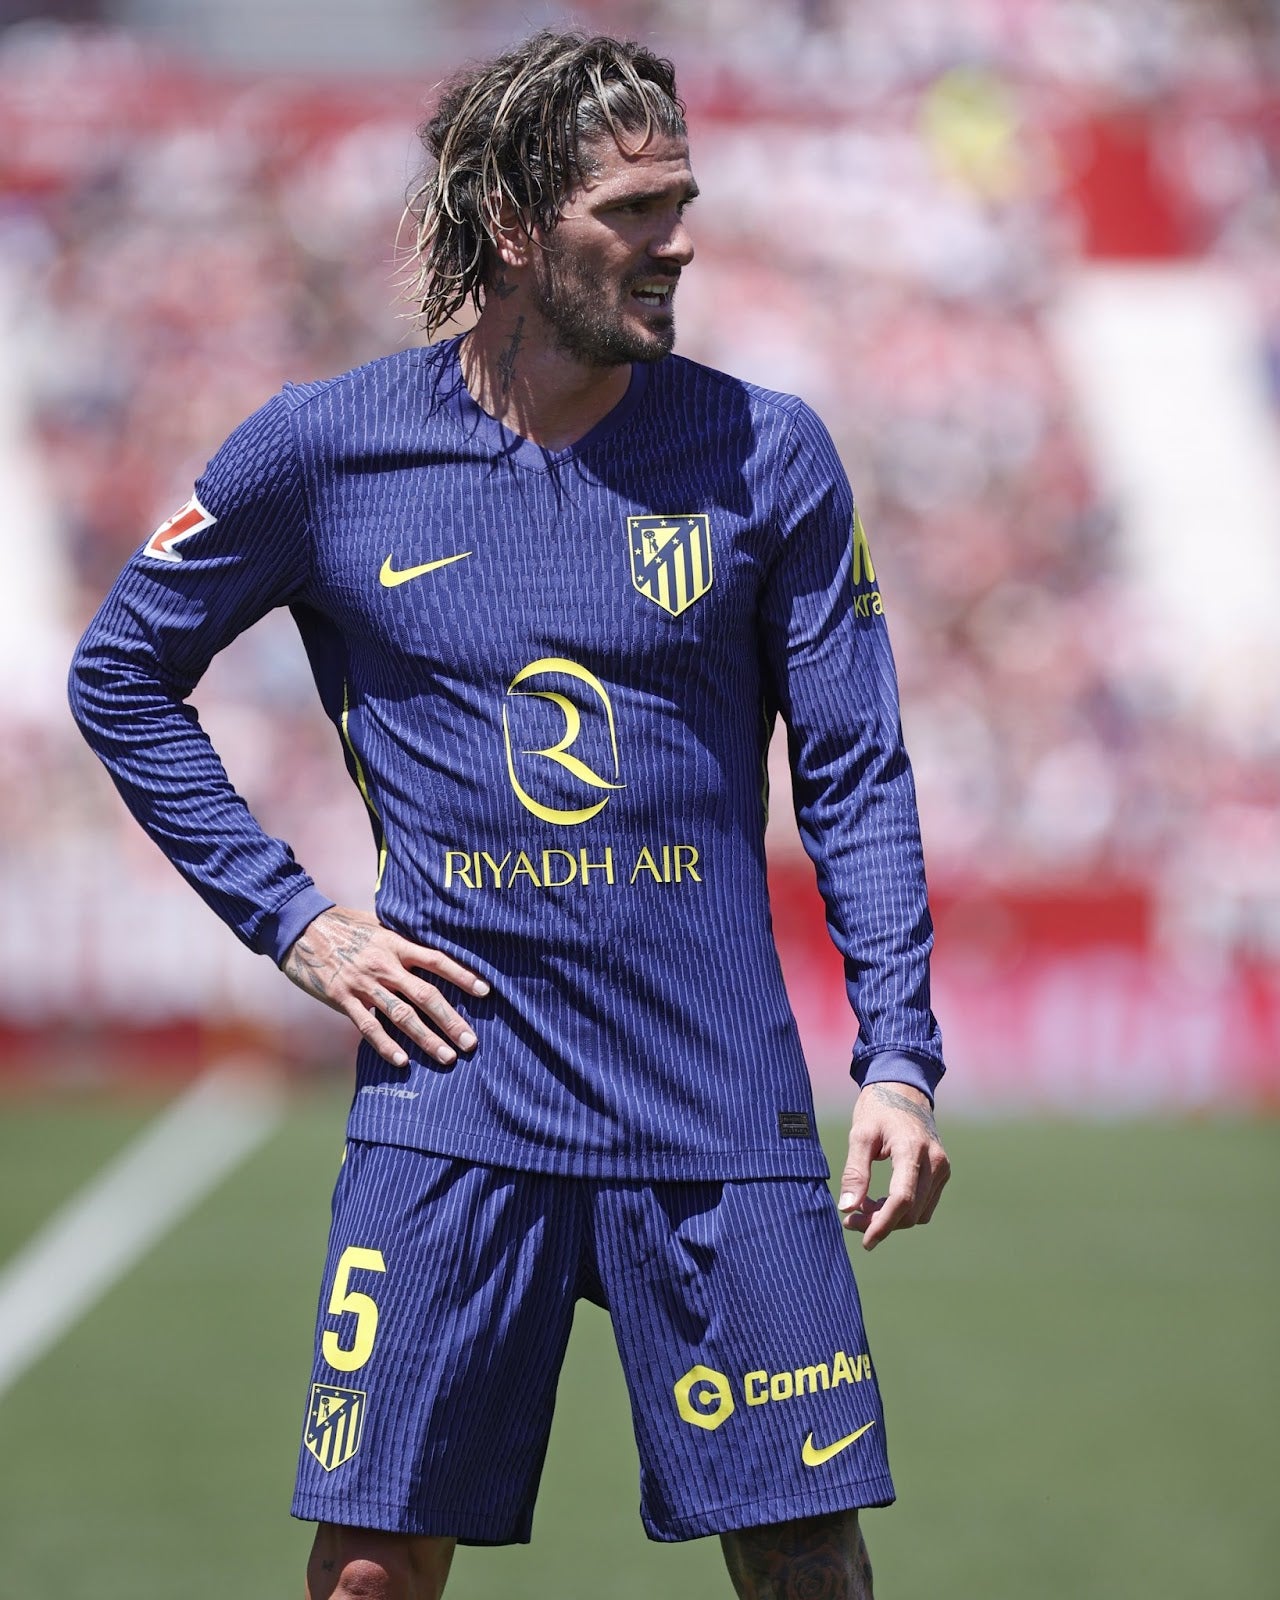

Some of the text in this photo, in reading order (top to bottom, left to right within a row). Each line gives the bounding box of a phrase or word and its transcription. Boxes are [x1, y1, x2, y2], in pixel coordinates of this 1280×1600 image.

[444, 845, 703, 889] RIYADH AIR
[321, 1245, 387, 1372] 5
